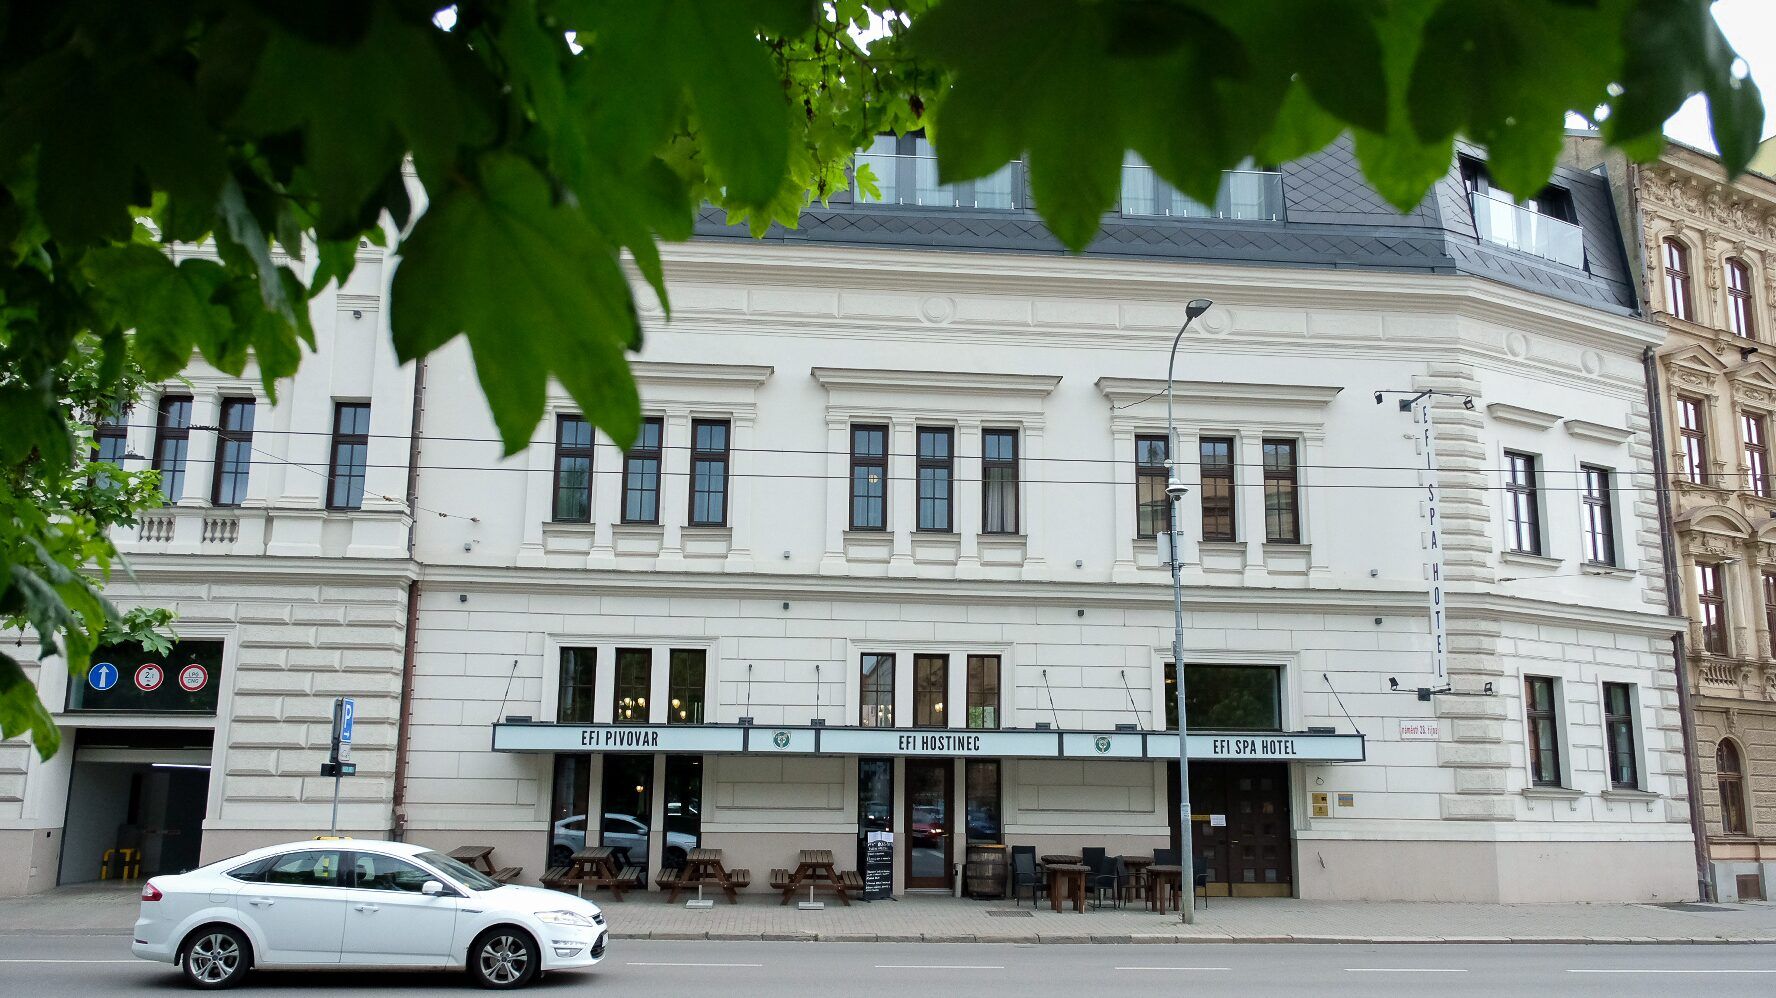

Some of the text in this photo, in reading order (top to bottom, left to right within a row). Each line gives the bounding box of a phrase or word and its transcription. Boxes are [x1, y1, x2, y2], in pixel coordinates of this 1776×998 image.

[1422, 405, 1443, 677] EFI SPA HOTEL
[581, 730, 659, 747] EFI PIVOVAR
[899, 735, 980, 751] EFI HOSTINEC
[1213, 739, 1297, 755] EFI SPA HOTEL
